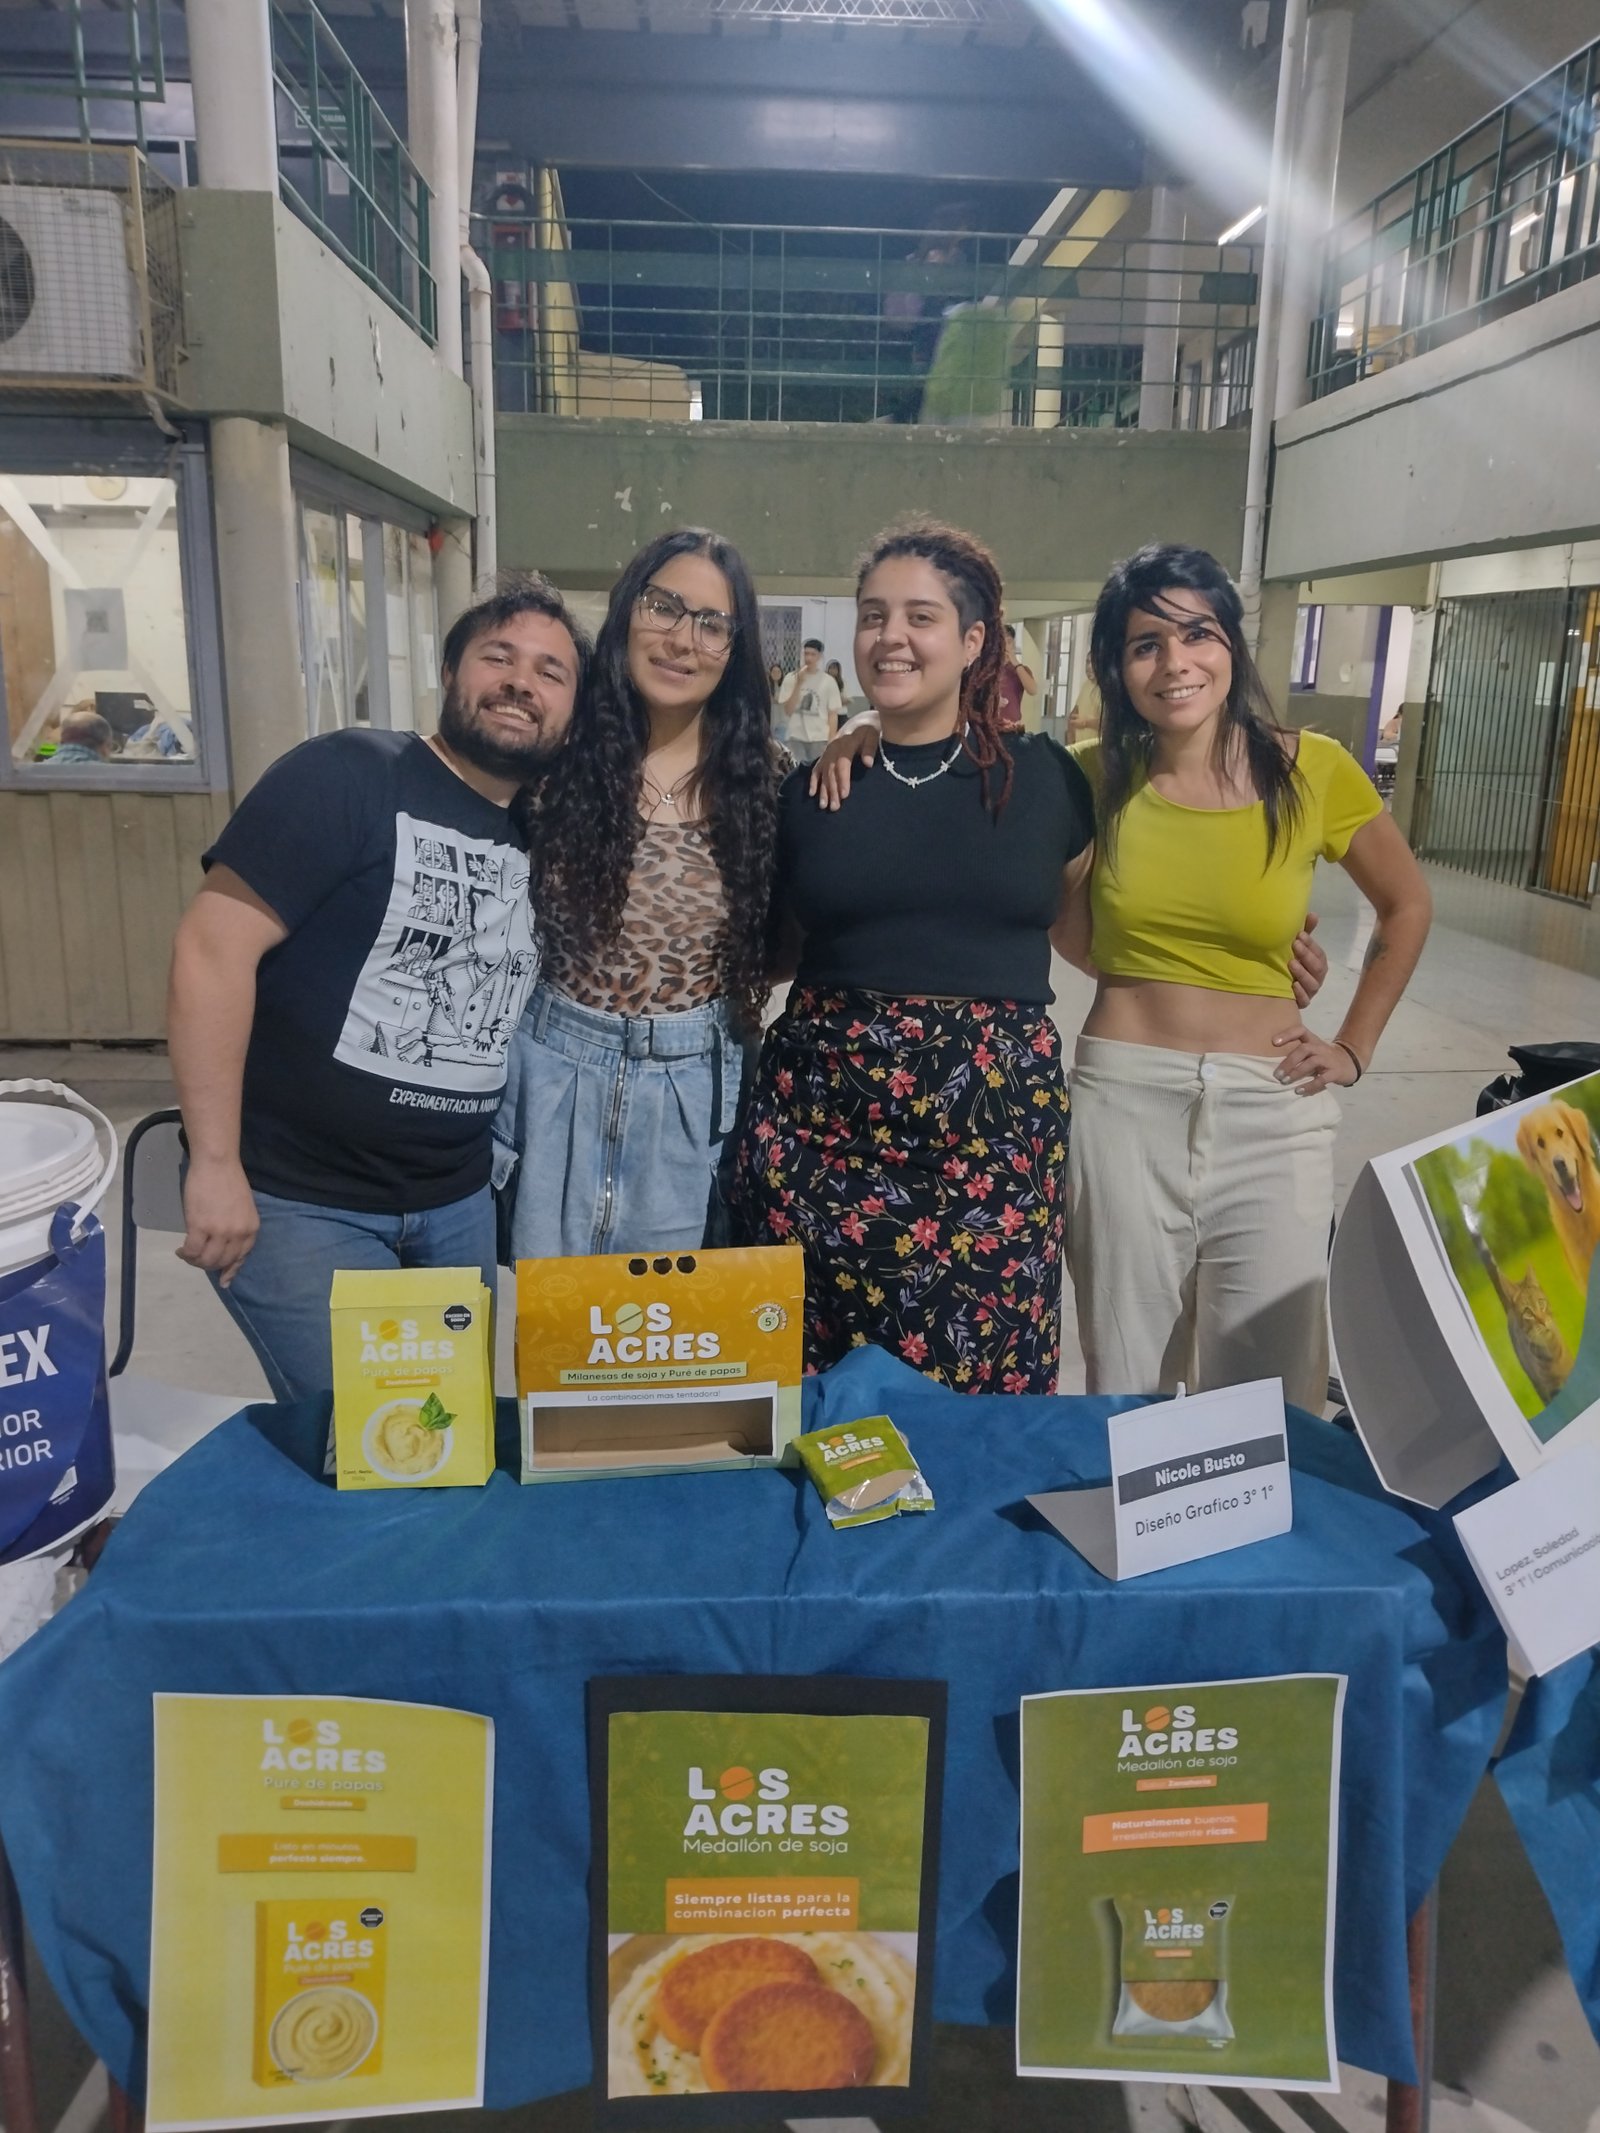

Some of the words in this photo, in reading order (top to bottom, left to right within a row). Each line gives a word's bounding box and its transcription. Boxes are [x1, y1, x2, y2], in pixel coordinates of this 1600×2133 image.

[389, 1087, 478, 1114] EXPERIMENTACIÓN
[590, 1302, 672, 1335] LOS
[361, 1319, 418, 1342] LOS
[360, 1339, 455, 1363] ACRES
[587, 1332, 720, 1364] ACRES
[414, 1365, 453, 1376] papas
[567, 1372, 618, 1381] Milanesas
[621, 1371, 634, 1380] de
[637, 1371, 657, 1383] soja
[661, 1371, 667, 1380] y
[669, 1368, 692, 1377] Puré
[695, 1368, 707, 1377] de
[710, 1367, 741, 1377] papas
[587, 1394, 598, 1402] La
[657, 1392, 674, 1400] mas
[677, 1390, 721, 1399] tentadora!
[0, 1409, 43, 1438] OR
[817, 1433, 857, 1450] LOS
[824, 1436, 885, 1462] ACRES
[1155, 1464, 1200, 1487] Nicole
[1204, 1452, 1246, 1474] Busto
[1136, 1512, 1182, 1536] Diseño
[1185, 1496, 1239, 1519] Grafico
[1533, 1527, 1579, 1558] Soledad
[1122, 1705, 1196, 1733] LOS
[262, 1717, 341, 1746] LOS
[1118, 1727, 1239, 1758] ACRES
[260, 1747, 387, 1773] ACRES
[1117, 1756, 1182, 1773] Medallón
[1187, 1756, 1205, 1768] de
[1209, 1754, 1238, 1770] soja
[305, 1778, 325, 1790] de
[332, 1780, 384, 1792] papas
[688, 1766, 790, 1800] LOS
[683, 1804, 849, 1836] ACRES
[1112, 1817, 1192, 1830] Naturalmente
[1112, 1829, 1203, 1841] irresistiblemente
[683, 1838, 772, 1853] Medallón
[778, 1838, 804, 1852] de
[809, 1839, 848, 1855] soja
[269, 1855, 317, 1864] perfecto
[674, 1893, 742, 1906] Siempre
[748, 1893, 791, 1904] listas
[797, 1894, 831, 1904] para
[837, 1892, 850, 1903] la
[783, 1906, 851, 1919] perfecta
[1144, 1908, 1184, 1924] LOS
[287, 1920, 348, 1942] LOS
[1144, 1924, 1205, 1940] ACRES
[284, 1940, 374, 1961] ACRES
